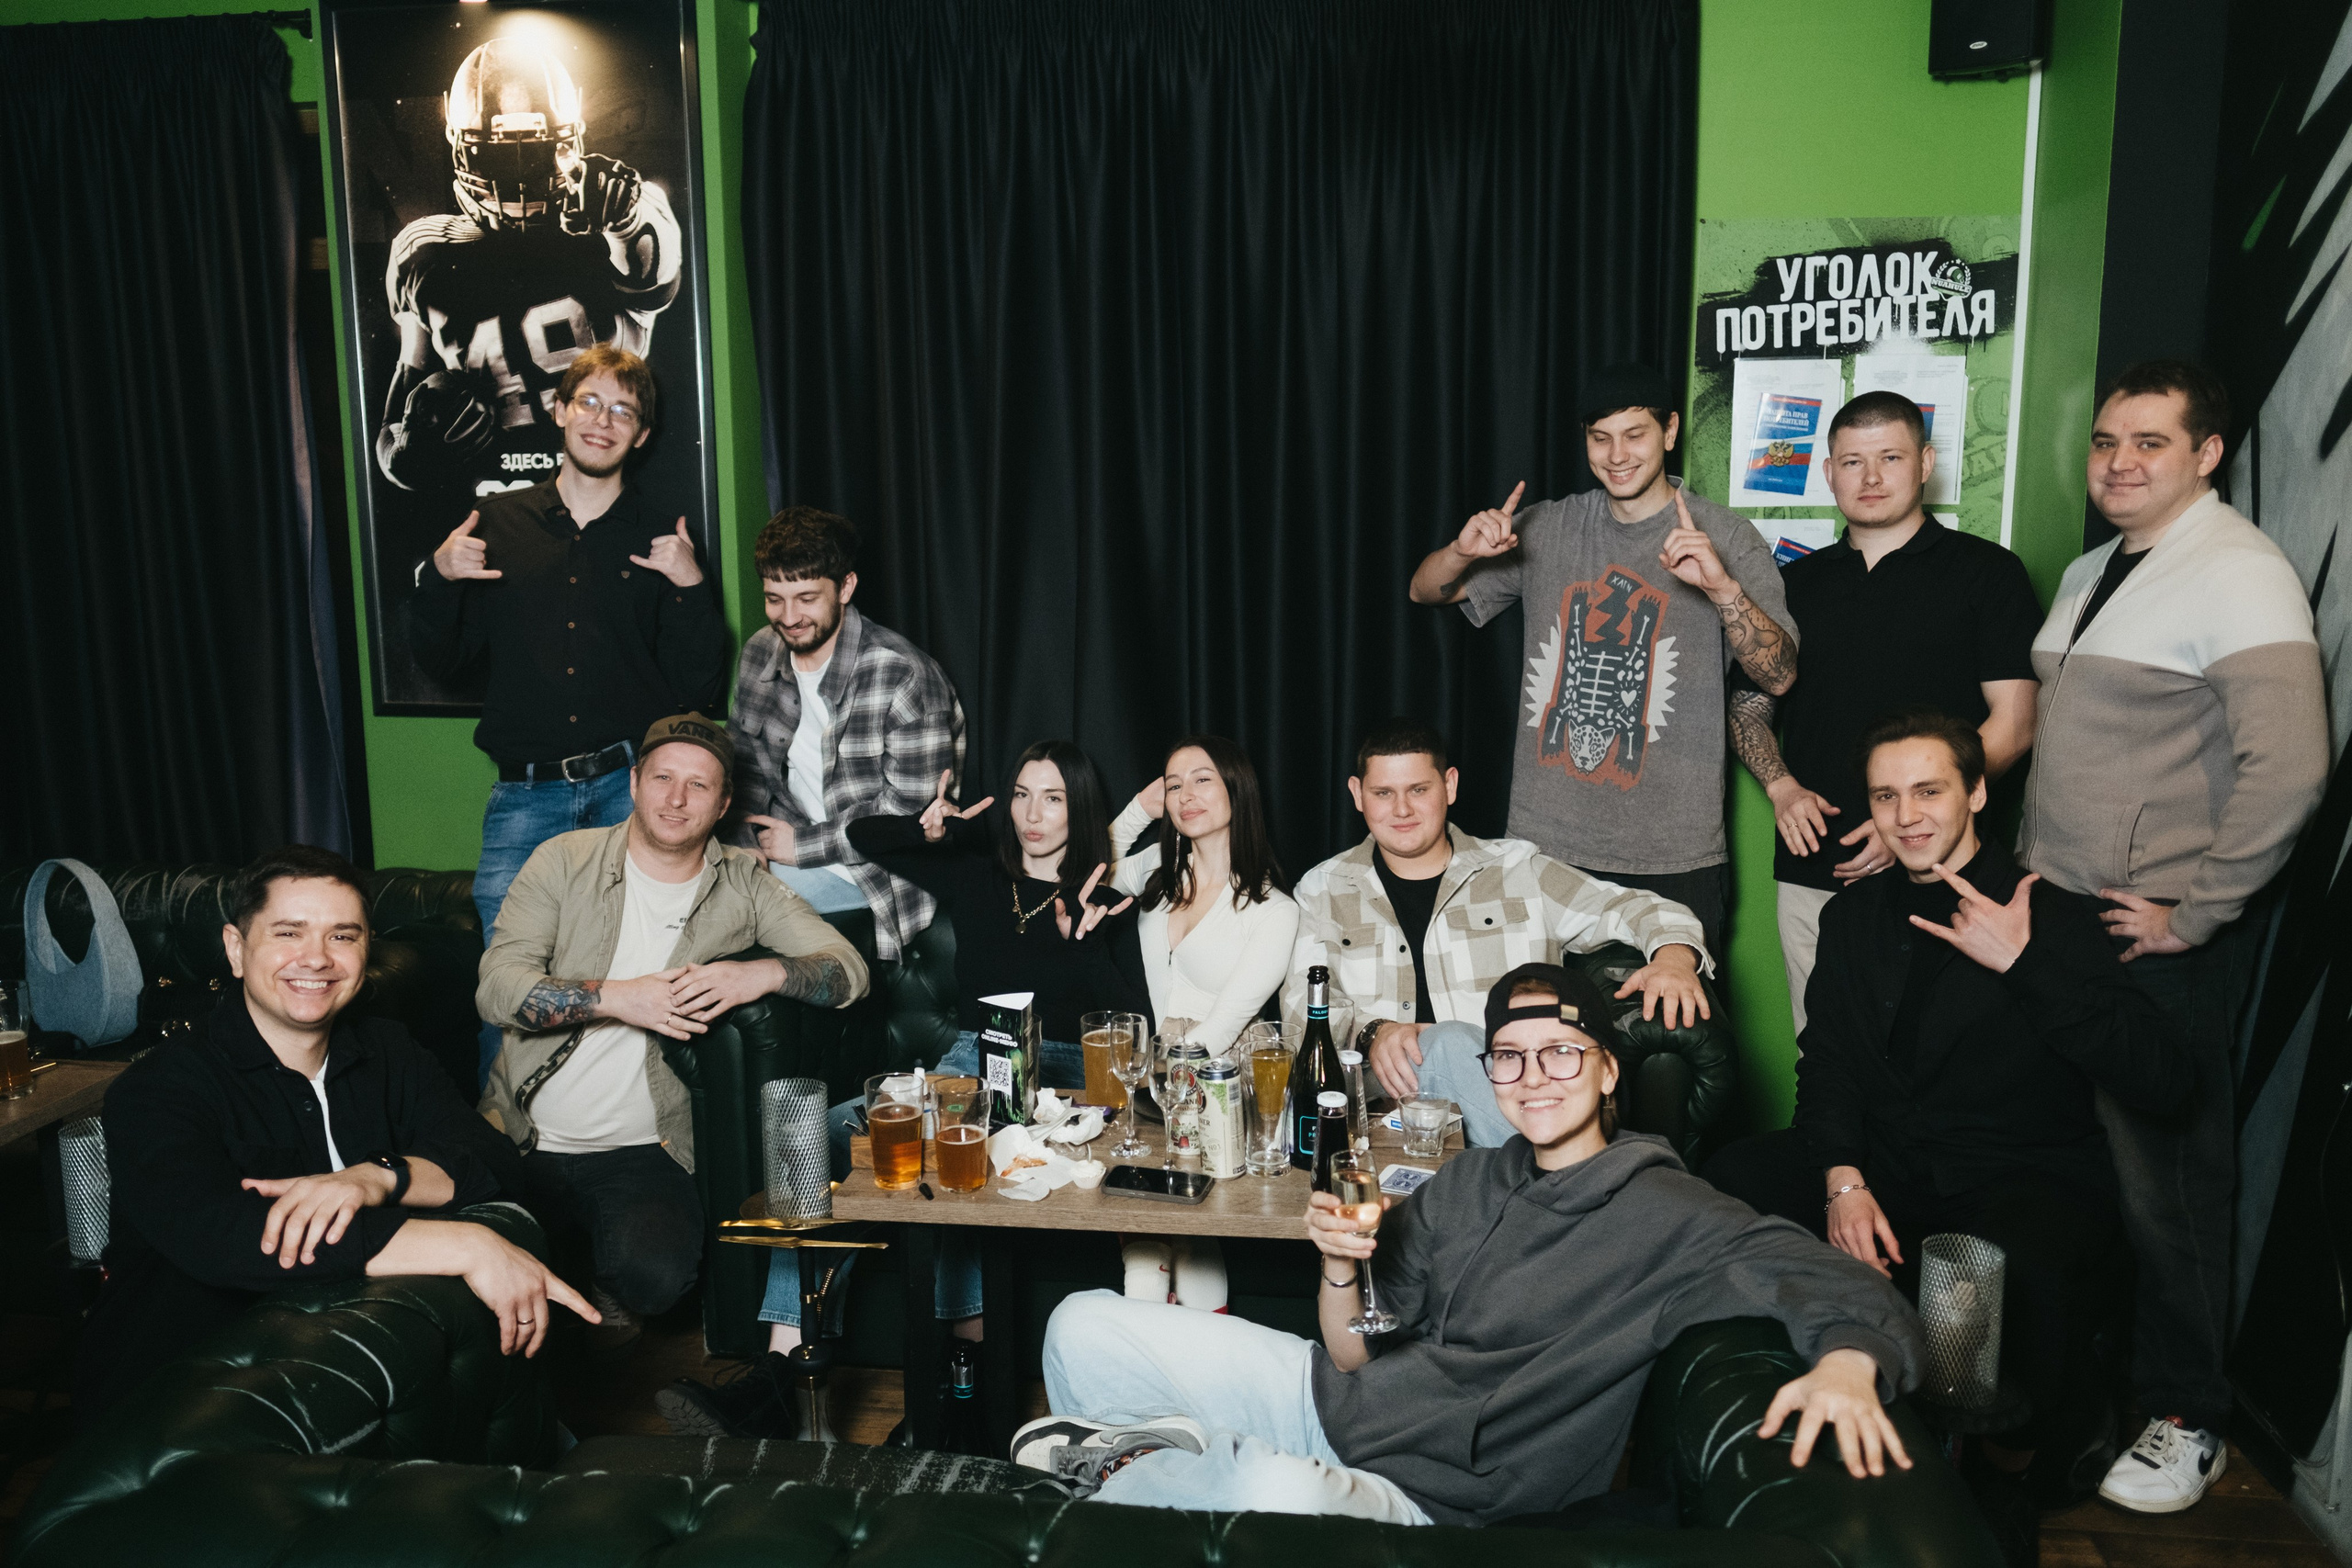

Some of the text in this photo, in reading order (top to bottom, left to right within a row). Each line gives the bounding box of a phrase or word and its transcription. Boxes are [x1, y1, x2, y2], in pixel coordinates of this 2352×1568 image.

[1776, 251, 1939, 302] УГОЛОК
[1715, 289, 1996, 354] ПОТРЕБИТЕЛЯ
[501, 453, 554, 472] ЗДЕСЬ
